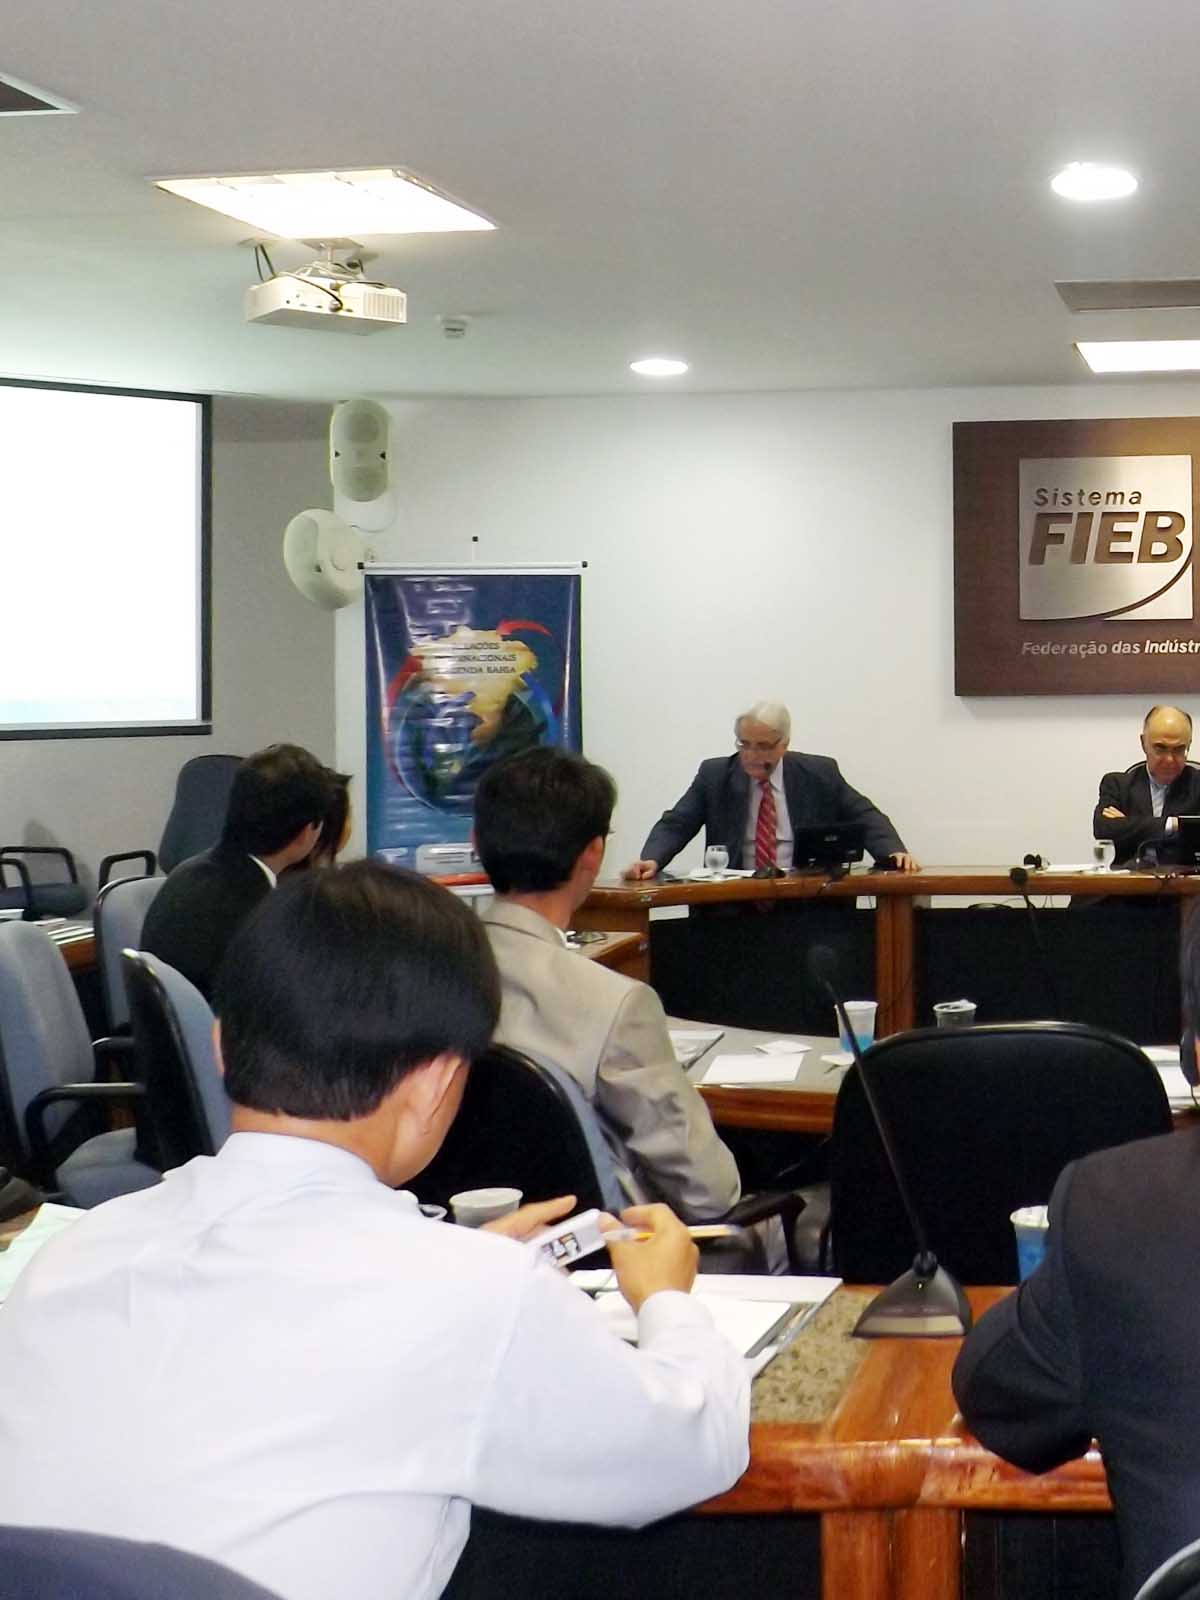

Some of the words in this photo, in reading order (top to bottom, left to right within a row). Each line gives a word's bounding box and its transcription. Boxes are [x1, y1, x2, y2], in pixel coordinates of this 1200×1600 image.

[1033, 487, 1143, 506] Sistema
[1028, 510, 1187, 566] FIEB
[1021, 641, 1108, 659] Federação
[1111, 640, 1141, 654] das
